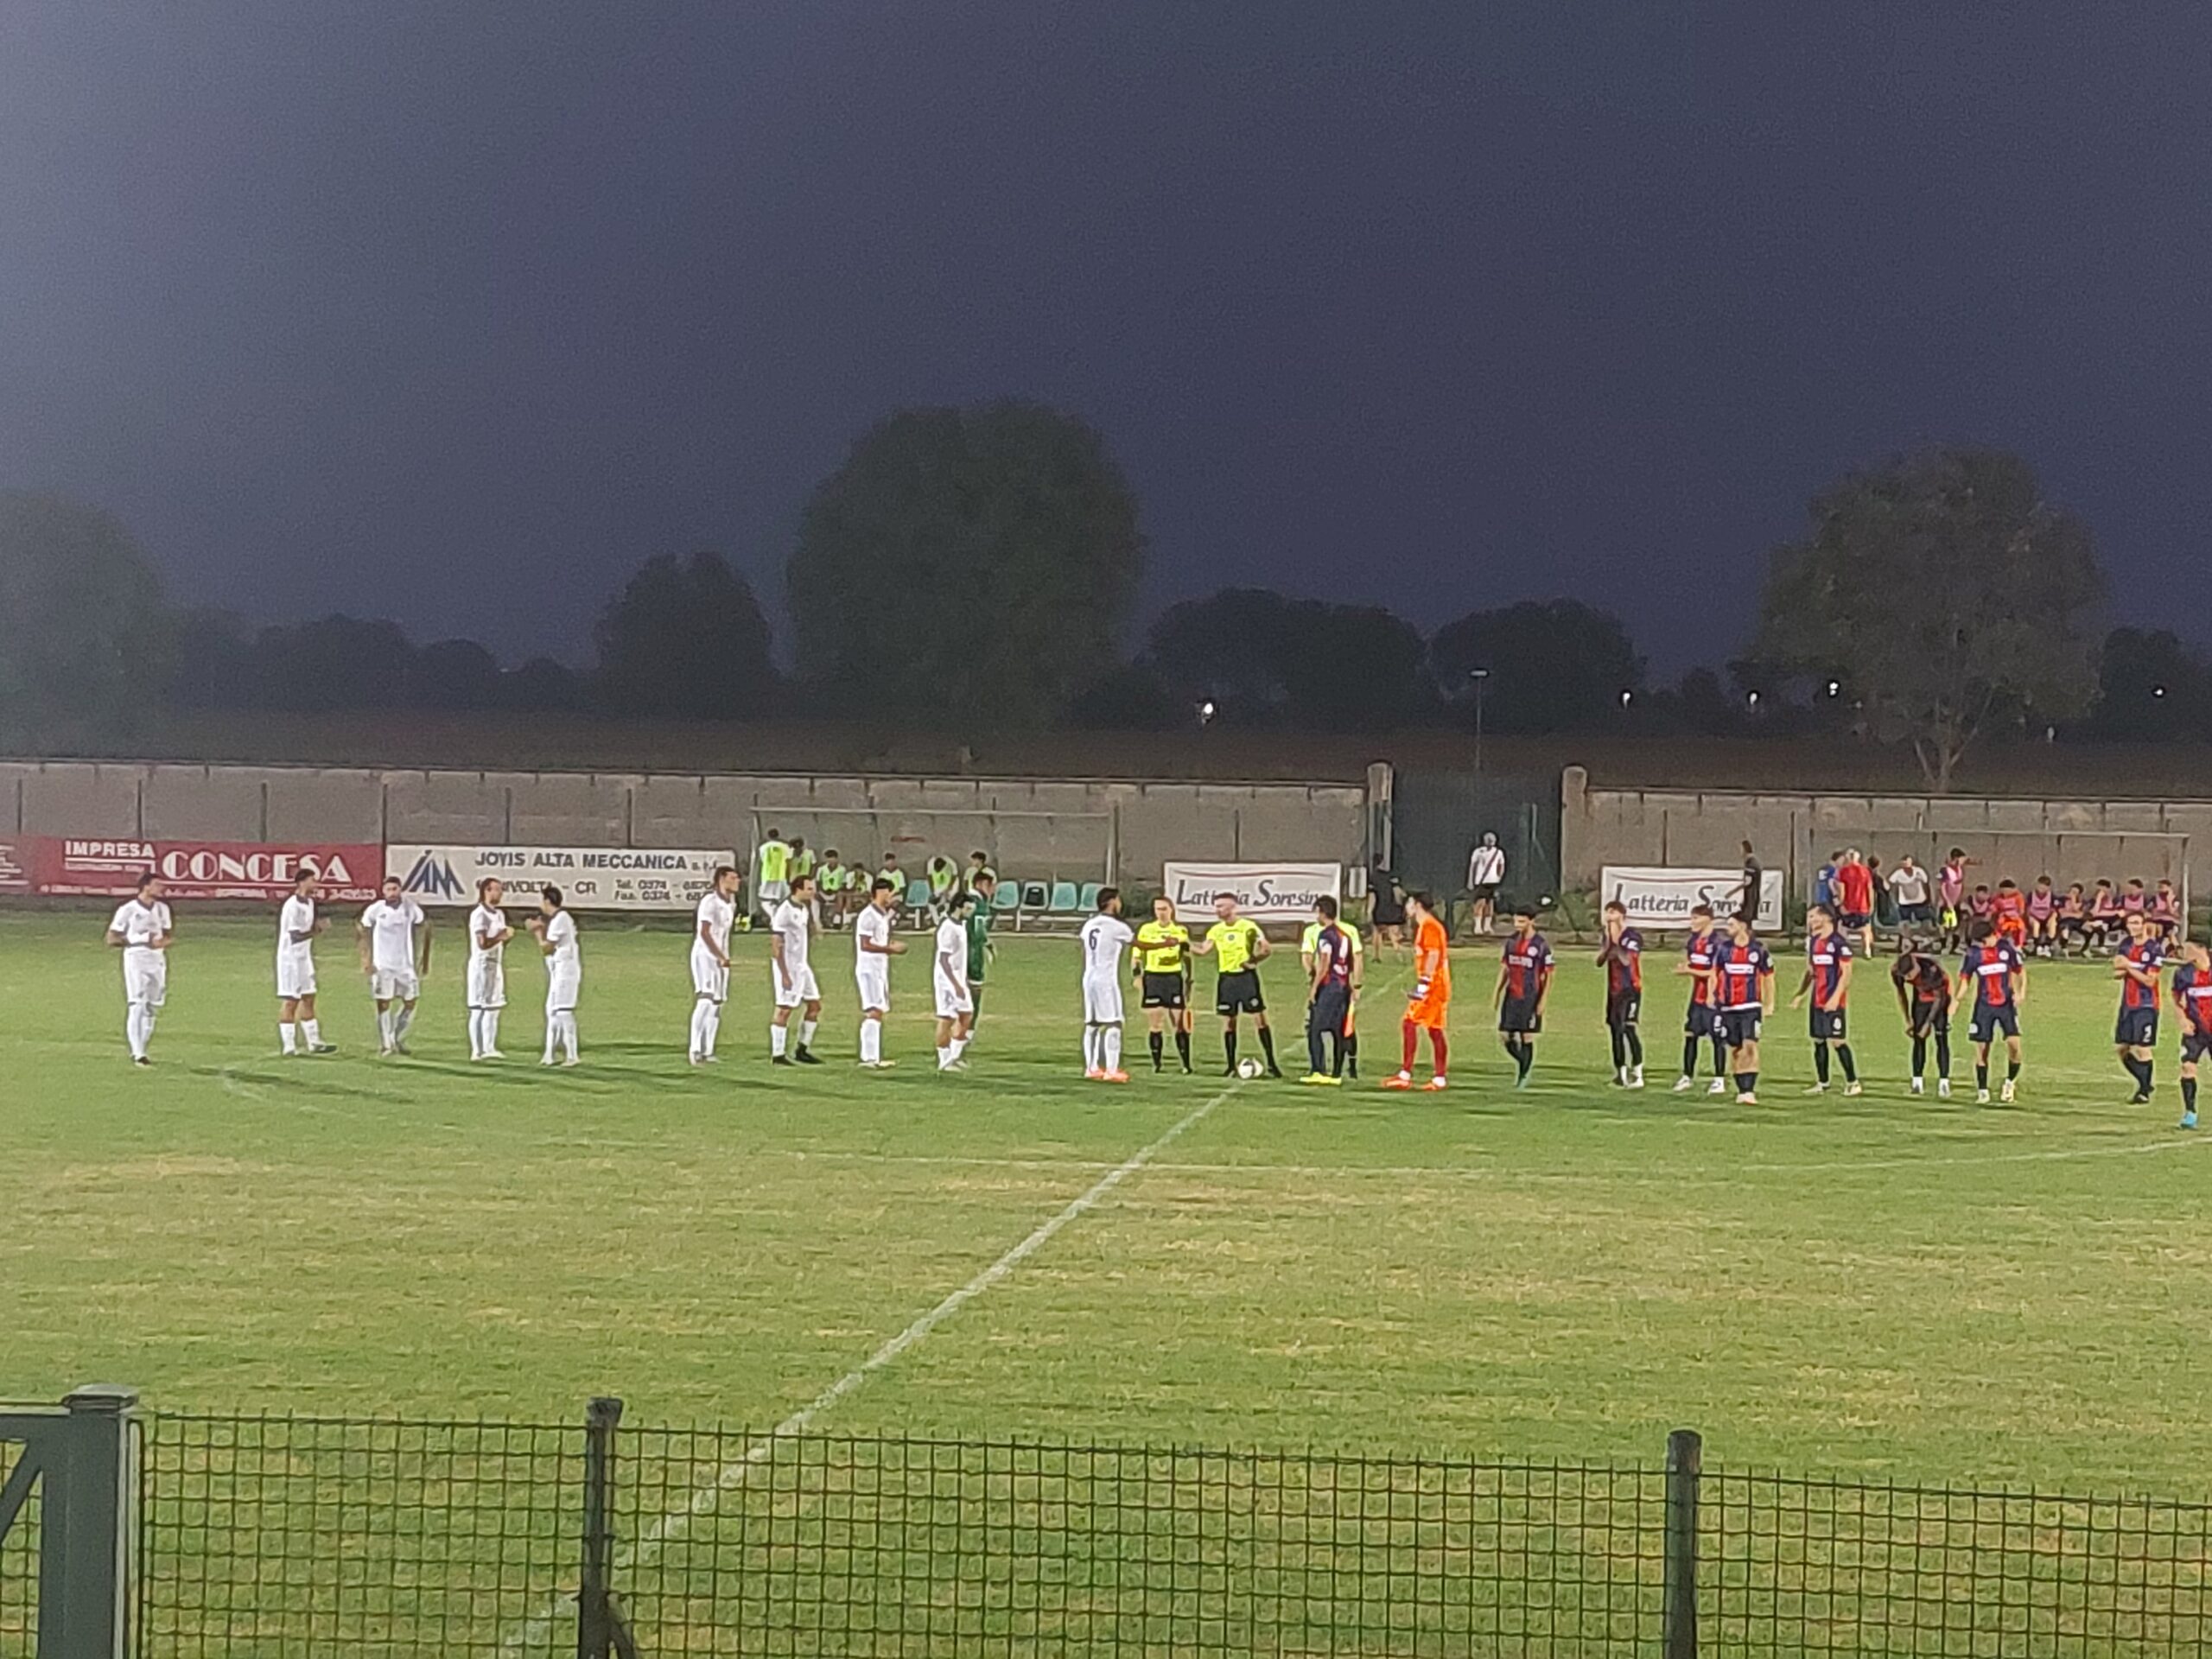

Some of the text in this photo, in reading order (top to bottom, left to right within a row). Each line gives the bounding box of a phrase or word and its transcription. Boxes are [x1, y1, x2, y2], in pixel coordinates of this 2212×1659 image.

[65, 840, 156, 858] IMPRESA
[162, 850, 353, 883] CONCESA
[533, 852, 575, 868] ALTA
[582, 854, 688, 870] MECCANICA
[575, 880, 597, 894] CR
[1176, 879, 1319, 906] Lattia Soresin
[1089, 928, 1101, 950] 6
